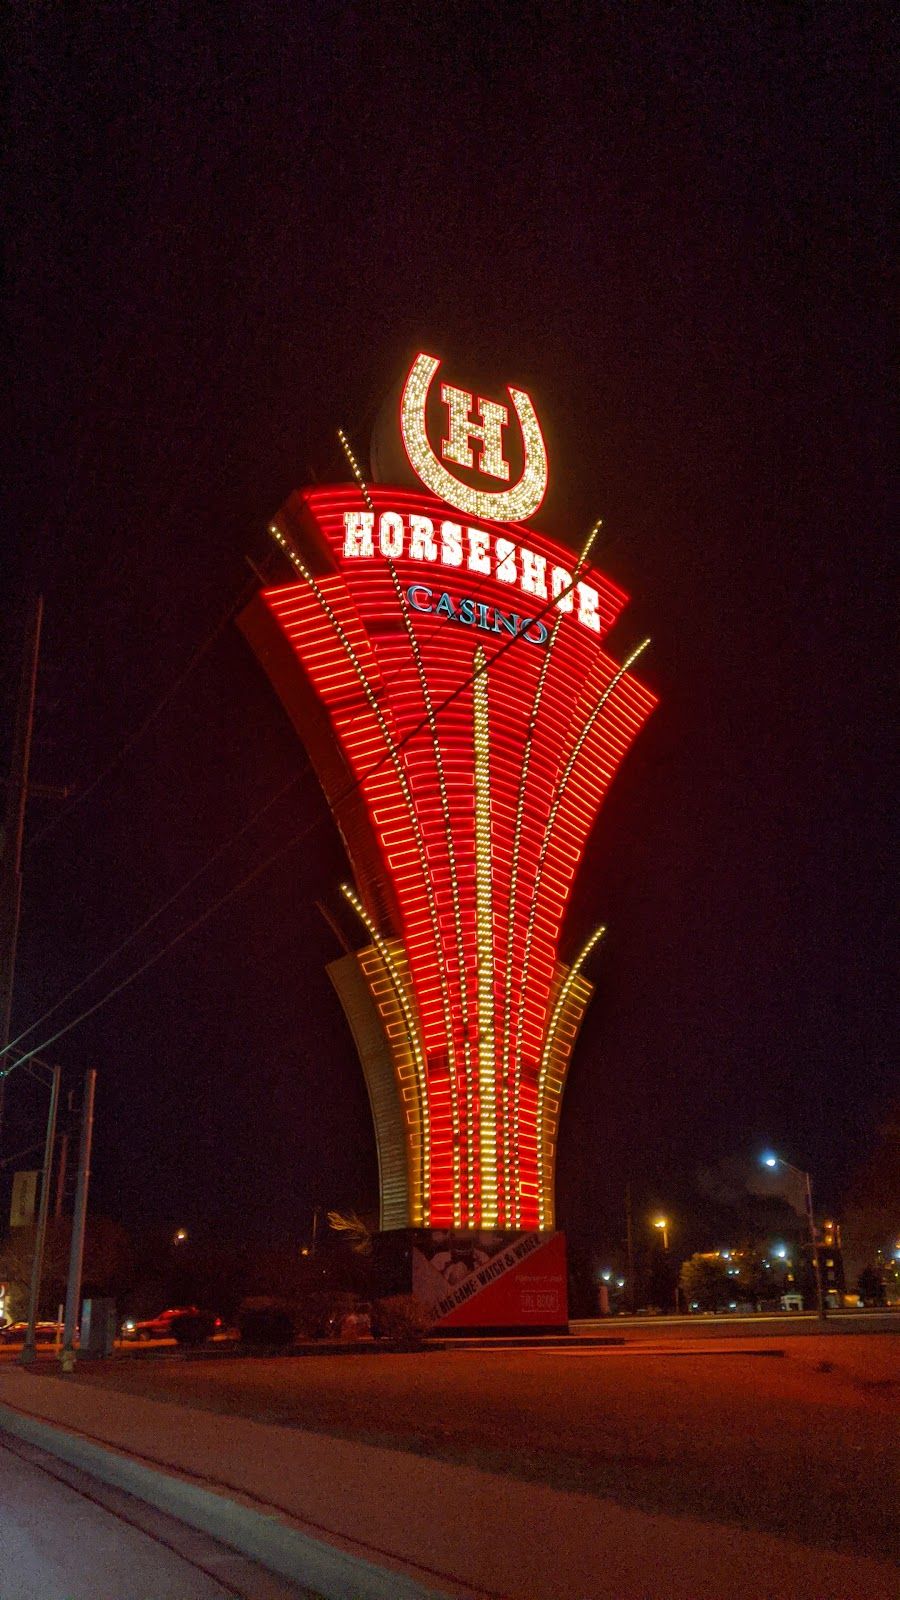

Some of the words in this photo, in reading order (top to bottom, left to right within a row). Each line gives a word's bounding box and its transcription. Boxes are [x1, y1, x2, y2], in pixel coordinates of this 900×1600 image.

[441, 383, 510, 481] H
[343, 511, 600, 632] HORSESHOE
[407, 585, 548, 644] CASINO
[477, 1259, 506, 1285] WATCH
[504, 1253, 515, 1267] &
